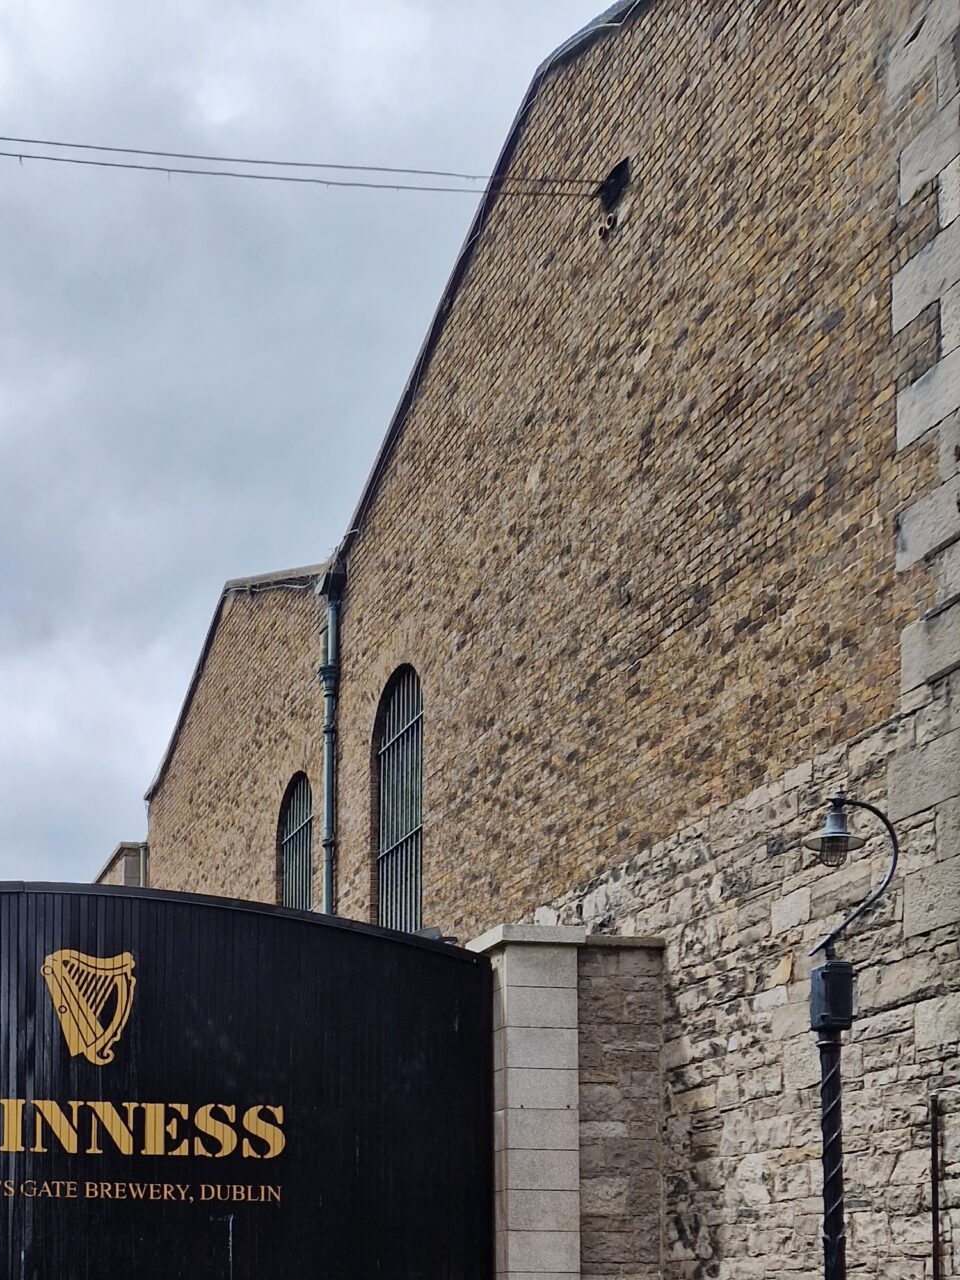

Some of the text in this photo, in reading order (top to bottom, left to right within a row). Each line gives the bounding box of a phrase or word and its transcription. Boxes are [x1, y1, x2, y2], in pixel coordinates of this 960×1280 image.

[20, 1180, 78, 1198] GATE
[84, 1182, 195, 1203] BREWERY,
[200, 1184, 282, 1202] DUBLIN
